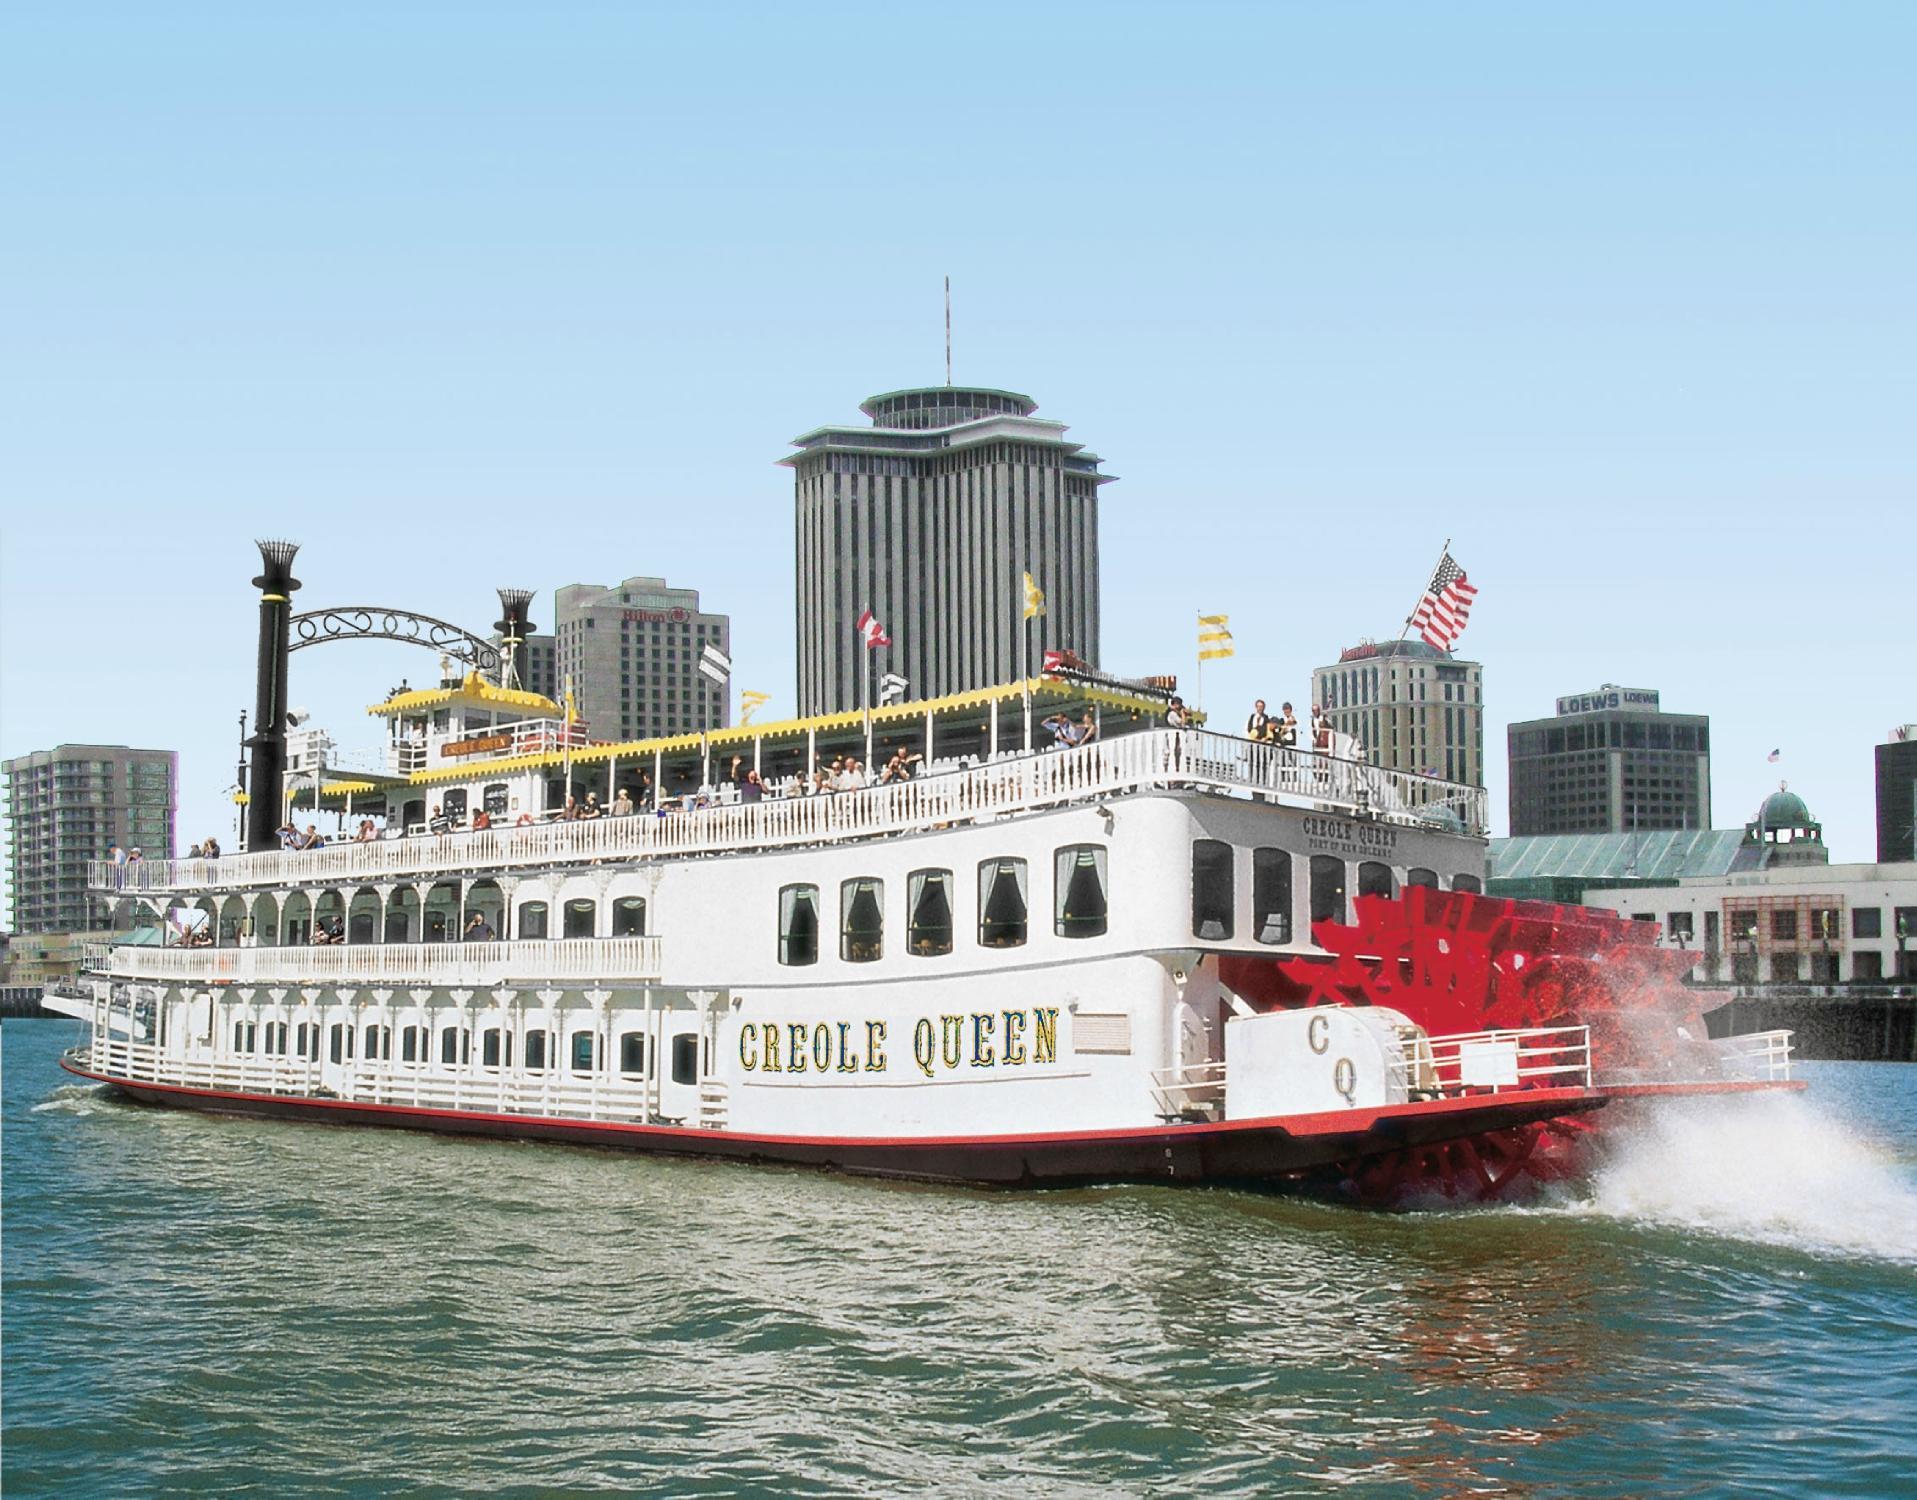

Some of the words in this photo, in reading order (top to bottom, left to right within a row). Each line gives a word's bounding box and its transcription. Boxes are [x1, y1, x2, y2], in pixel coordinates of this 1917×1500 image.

[1559, 693, 1618, 714] LOEWS
[1624, 692, 1659, 704] LOEWS
[1303, 817, 1351, 839] CREOLE
[1359, 825, 1397, 847] QUEEN
[739, 1020, 888, 1072] CREOLE
[914, 1007, 1060, 1077] QUEEN
[1309, 1015, 1329, 1055] C
[1334, 1057, 1356, 1107] Q
